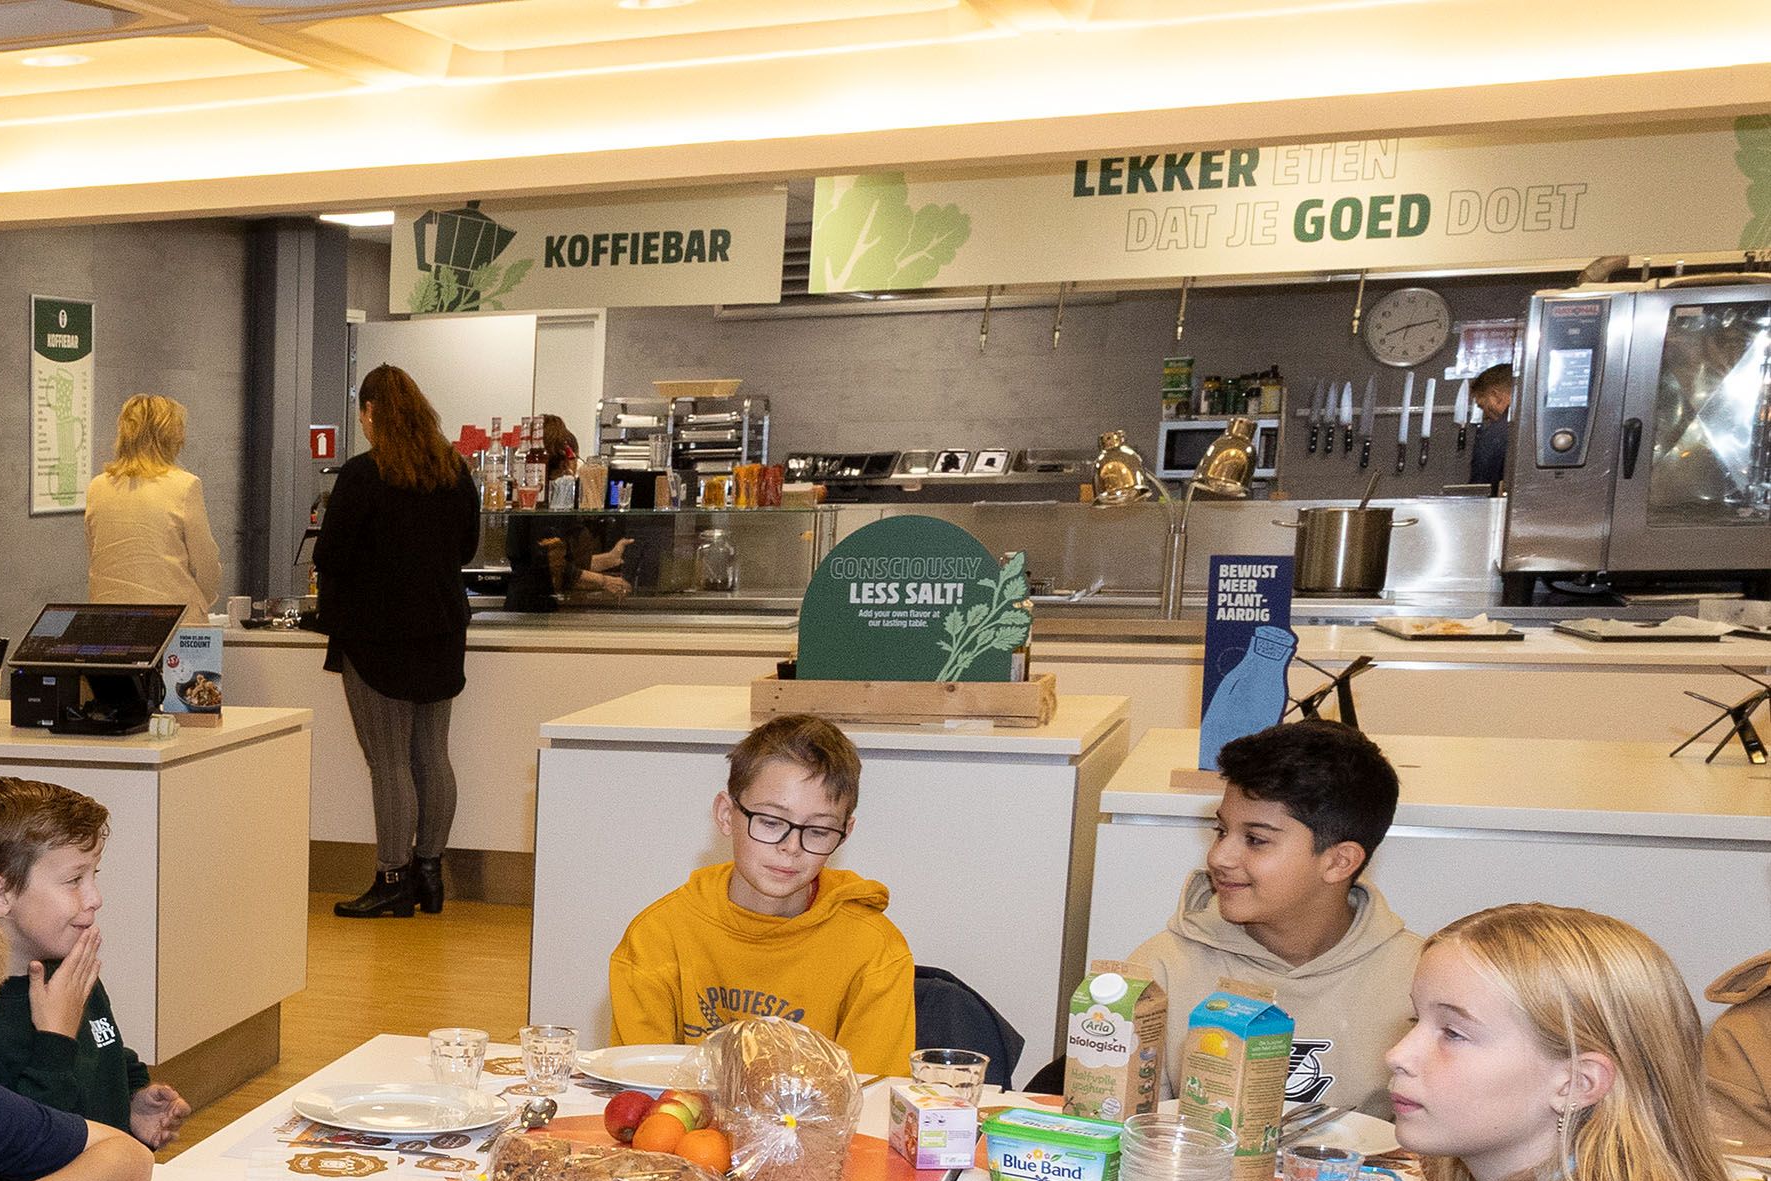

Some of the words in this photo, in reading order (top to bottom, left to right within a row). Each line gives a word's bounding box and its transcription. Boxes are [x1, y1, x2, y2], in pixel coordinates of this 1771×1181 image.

[1073, 147, 1261, 198] LEKKER
[1273, 137, 1400, 187] ETEN
[1125, 204, 1219, 252] DAT
[1225, 201, 1278, 248] JE
[1293, 194, 1430, 244] GOED
[1447, 184, 1587, 236] DOET
[545, 229, 731, 268] KOFFIEBAR
[830, 557, 983, 580] CONSCIOUSLY
[1219, 564, 1278, 579] BEWUST
[849, 582, 900, 604] LESS
[904, 582, 964, 605] SALT!
[1218, 579, 1257, 593] MEER
[1217, 593, 1268, 607] PLANT-
[858, 609, 873, 618] Add
[873, 611, 891, 620] your
[1216, 607, 1270, 622] AARDIG
[707, 986, 789, 1017] PROTEST
[1086, 1021, 1110, 1033] Arla
[1069, 1035, 1126, 1053] biologisch
[1003, 1153, 1037, 1172] Blue
[1041, 1161, 1082, 1180] Band
